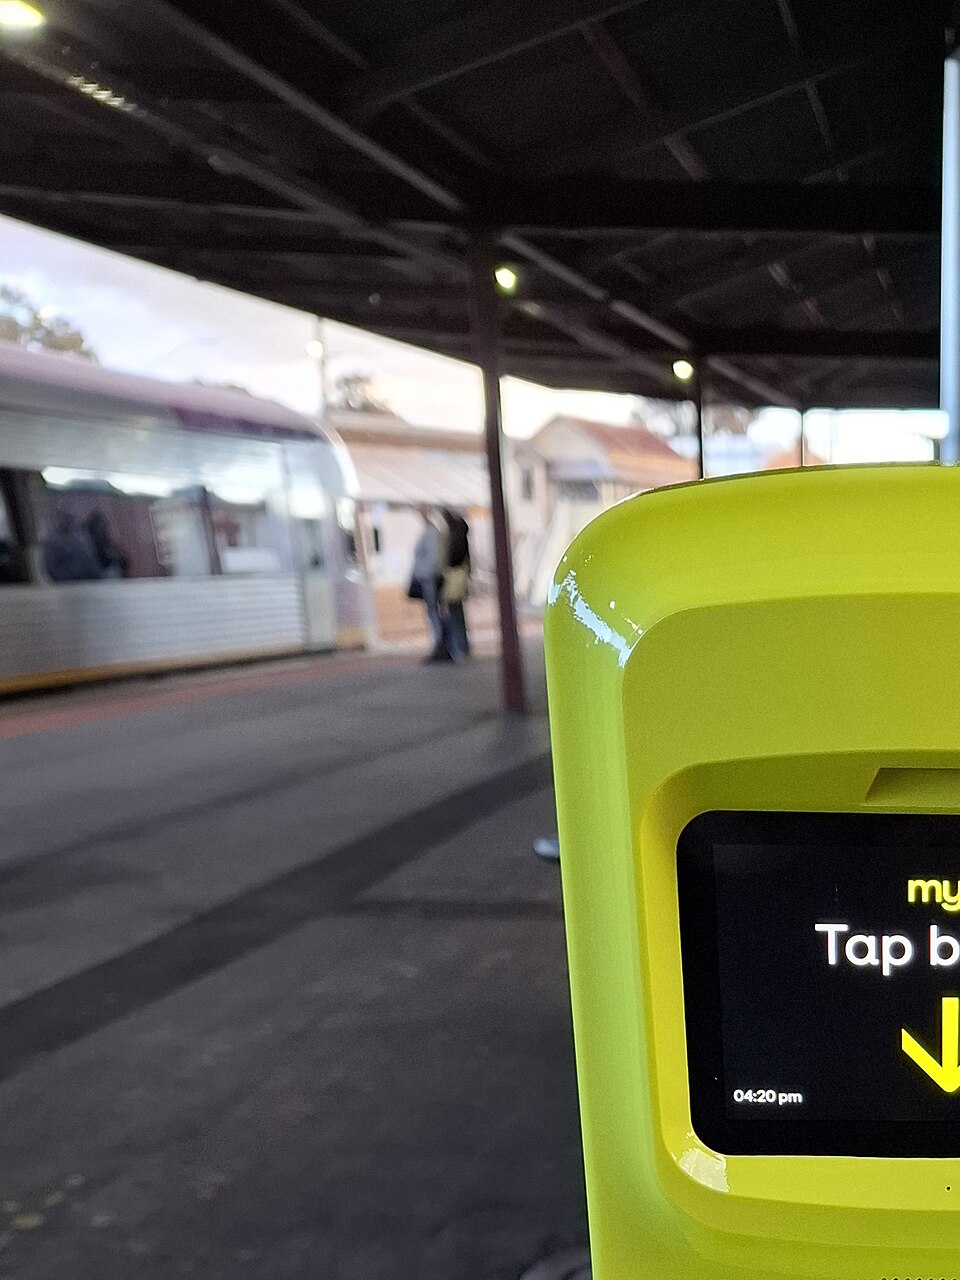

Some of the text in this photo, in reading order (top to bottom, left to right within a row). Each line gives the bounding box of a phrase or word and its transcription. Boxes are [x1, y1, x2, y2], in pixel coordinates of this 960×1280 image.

[815, 924, 915, 976] Tap
[733, 1090, 803, 1106] 04:20 pm
